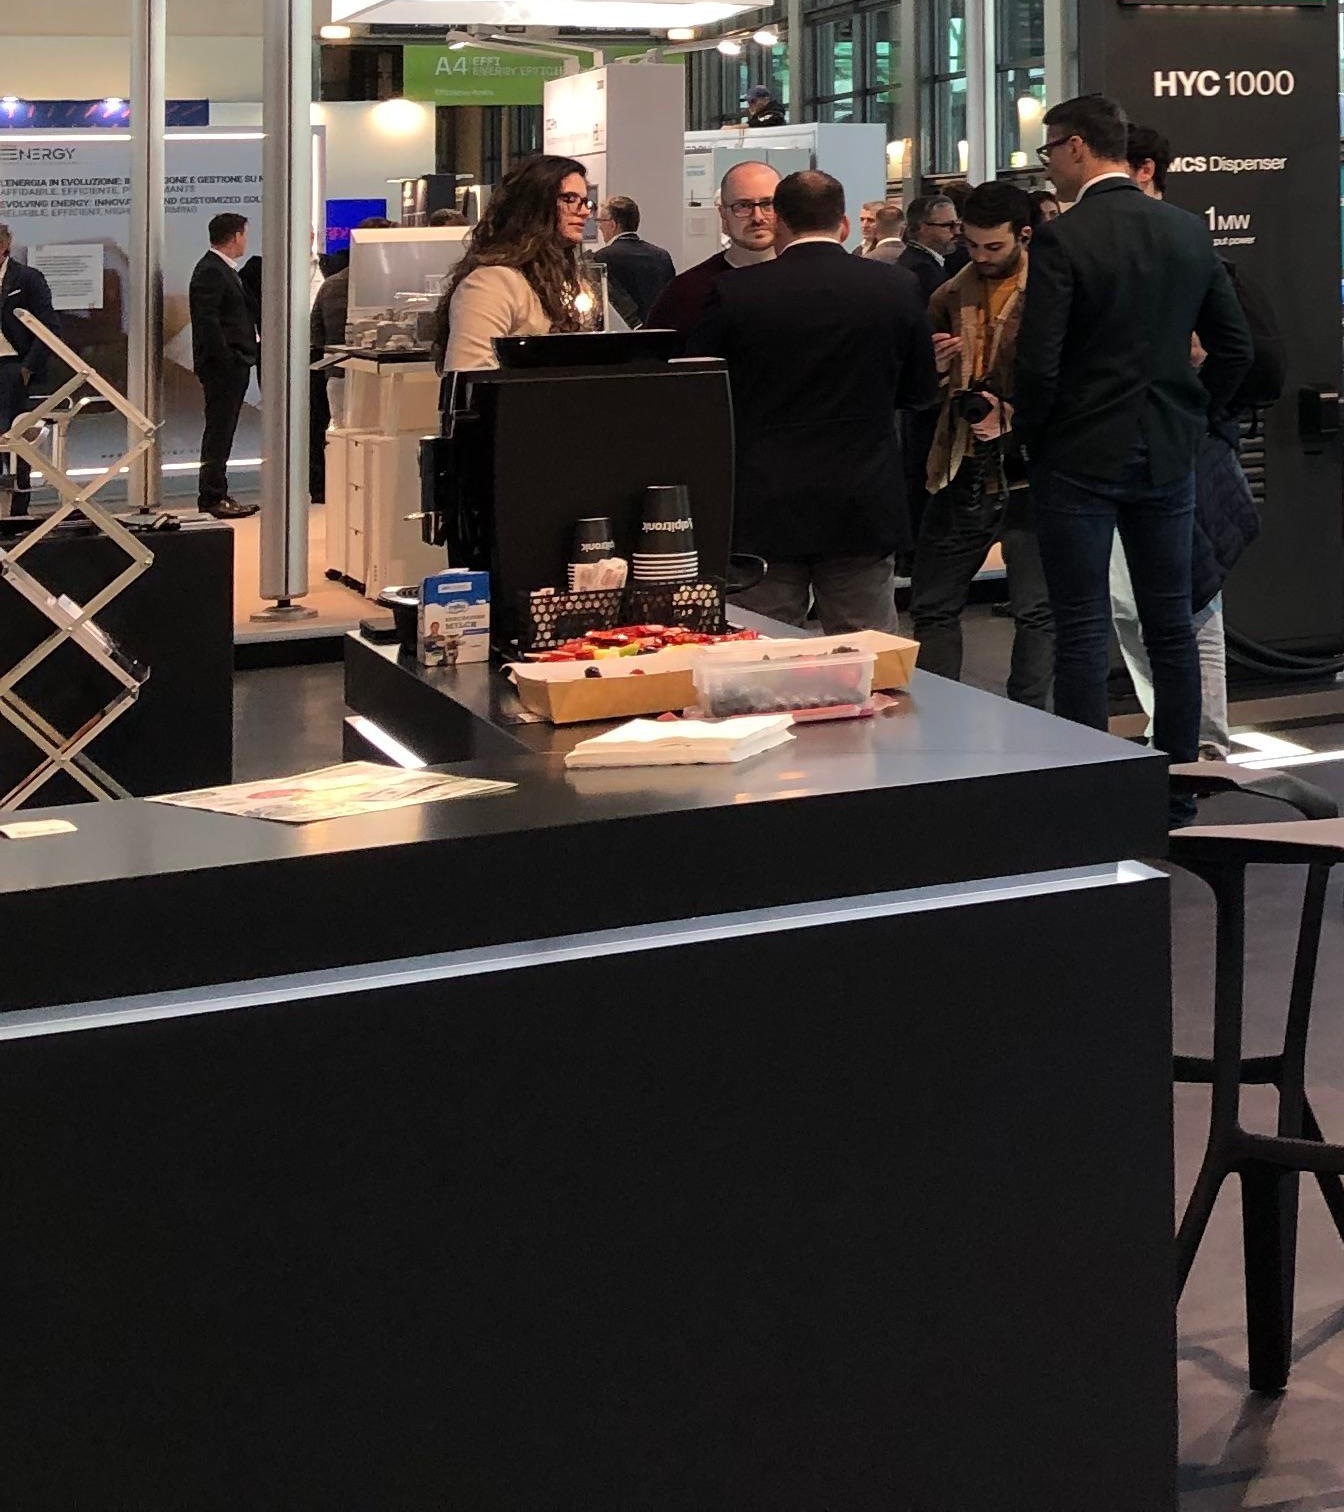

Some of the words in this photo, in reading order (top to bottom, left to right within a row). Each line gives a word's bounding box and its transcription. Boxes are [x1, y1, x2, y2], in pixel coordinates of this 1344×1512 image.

[434, 56, 468, 76] A4
[1153, 70, 1221, 97] HYC
[1225, 69, 1295, 96] 1000
[1209, 156, 1287, 175] Dispenser
